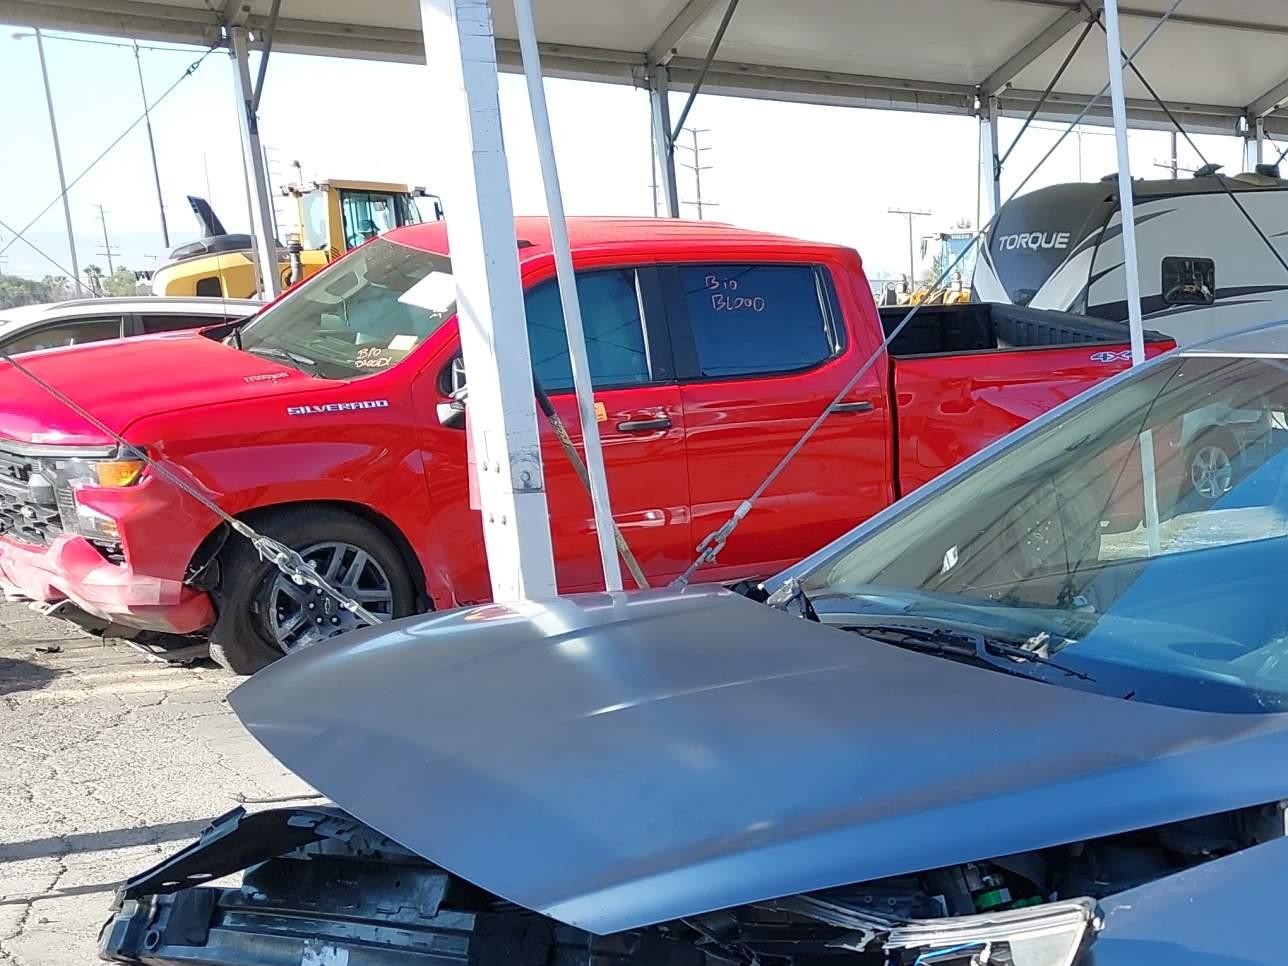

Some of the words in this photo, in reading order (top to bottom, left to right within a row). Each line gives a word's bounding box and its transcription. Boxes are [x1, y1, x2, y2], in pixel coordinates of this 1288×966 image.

[998, 231, 1071, 252] TORQUE
[711, 293, 765, 311] BLOOD
[286, 399, 389, 416] SILVERADO
